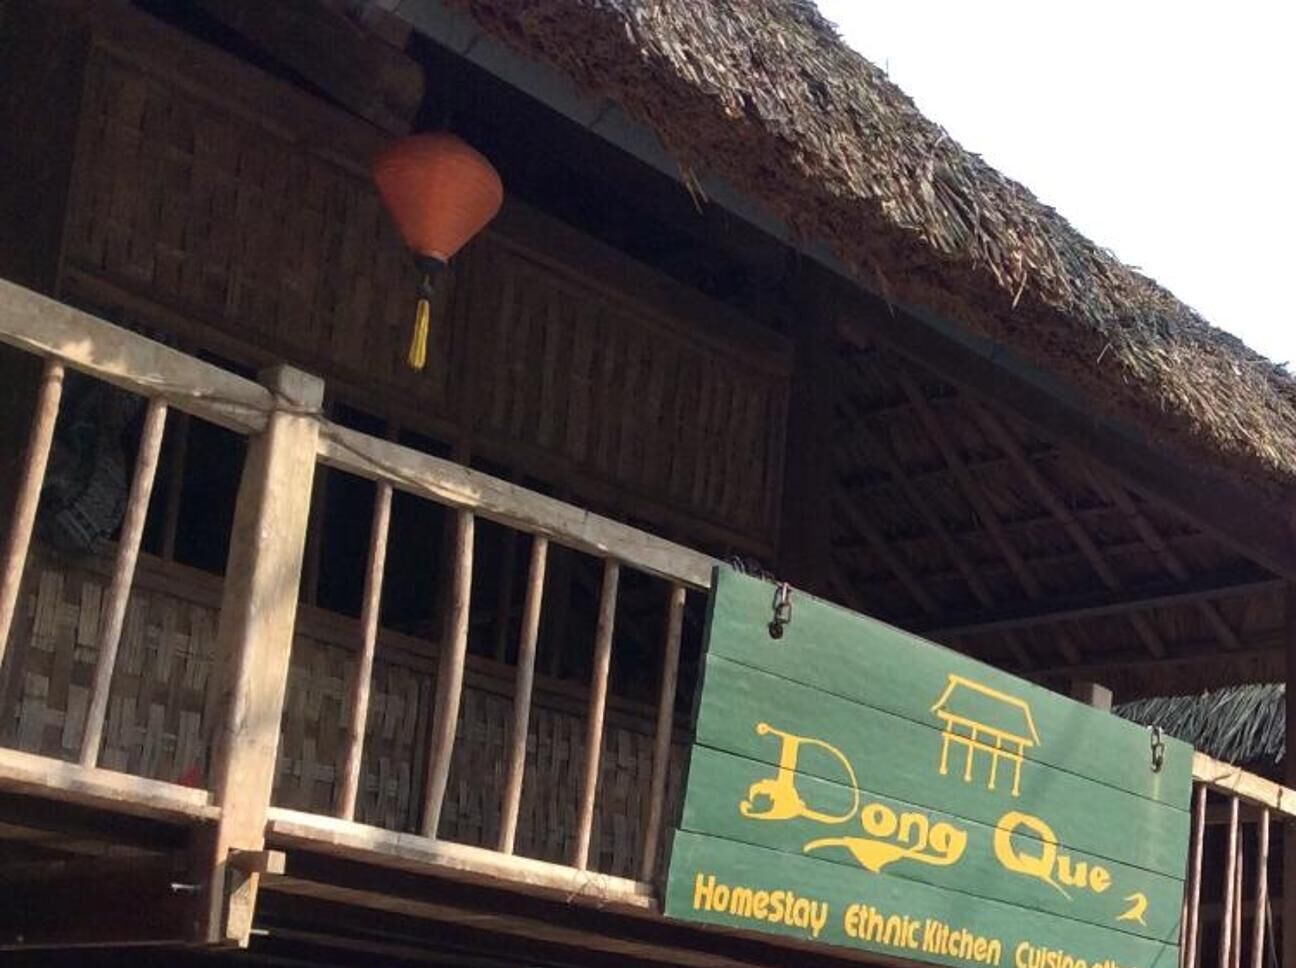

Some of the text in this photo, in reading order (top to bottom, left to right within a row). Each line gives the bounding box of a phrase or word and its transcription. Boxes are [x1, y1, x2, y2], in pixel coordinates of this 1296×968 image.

[739, 722, 1148, 926] Dong Que 2
[923, 918, 1002, 966] Kitchen
